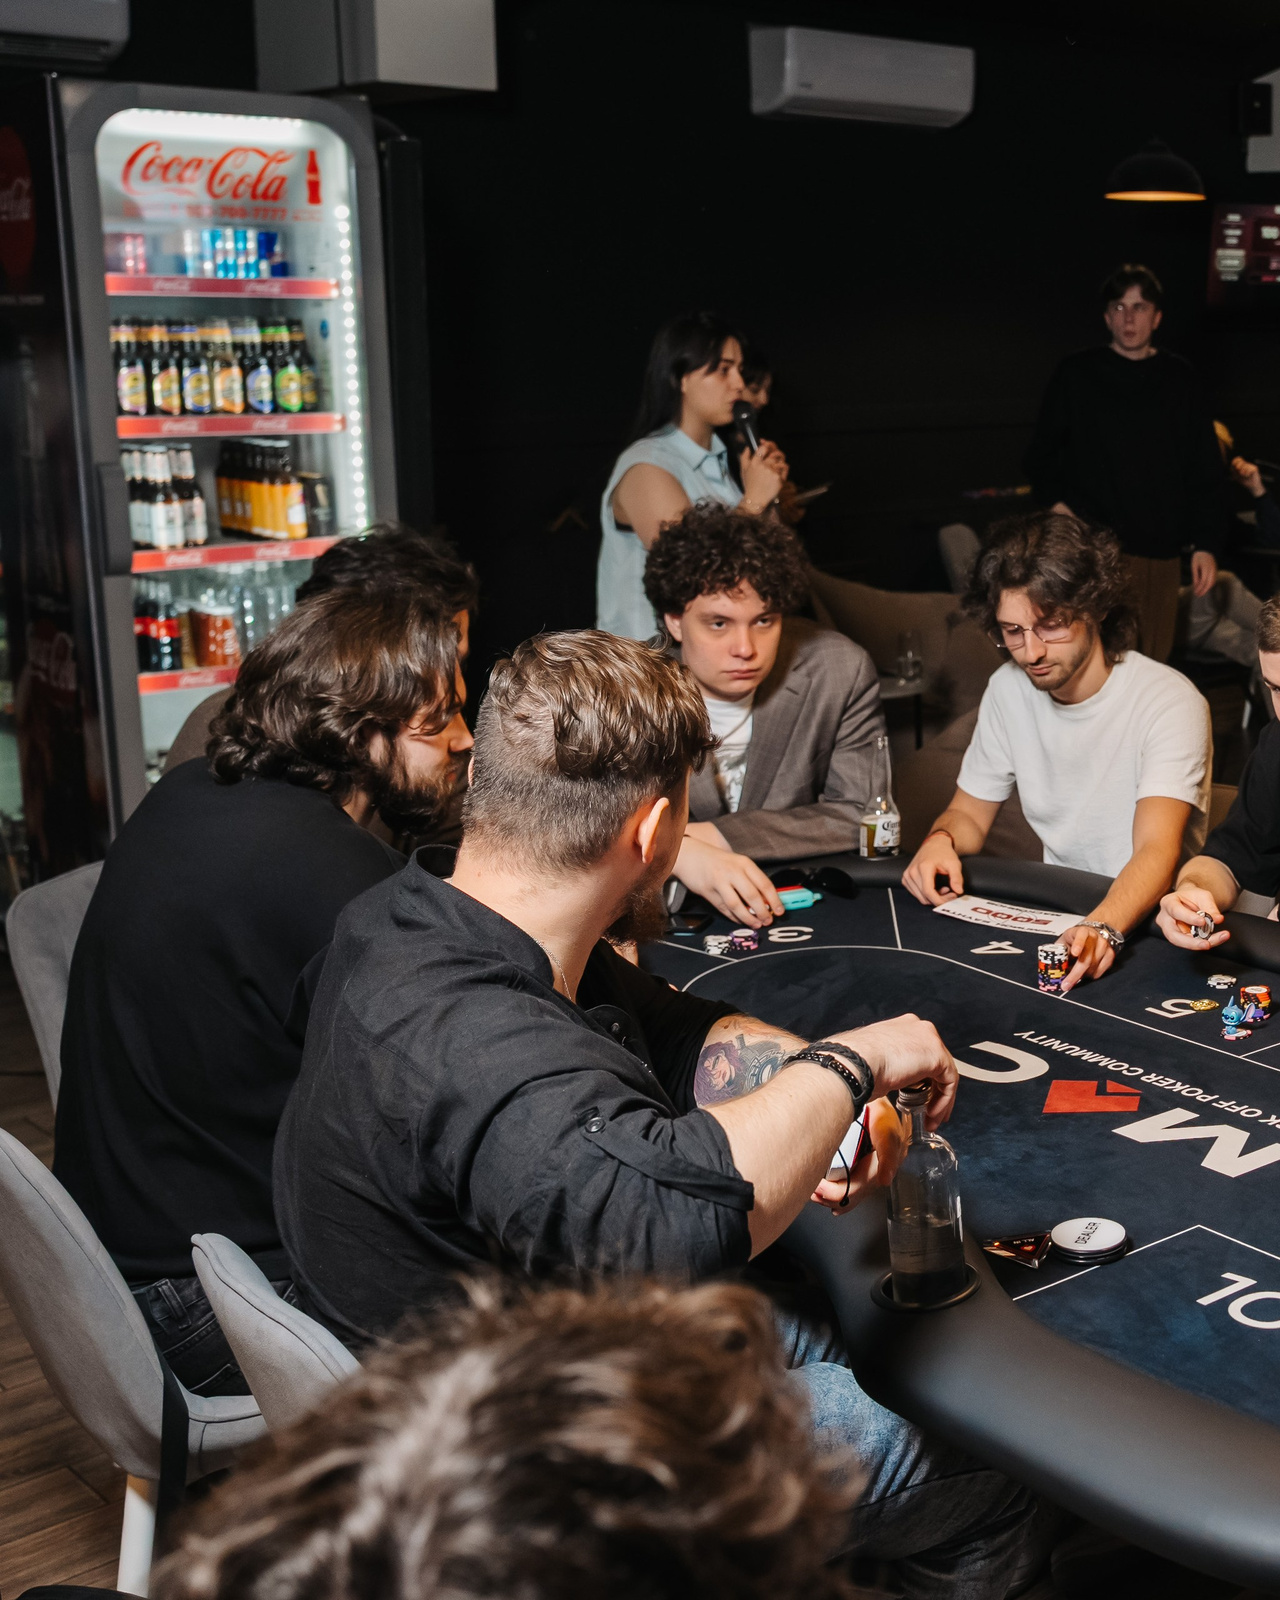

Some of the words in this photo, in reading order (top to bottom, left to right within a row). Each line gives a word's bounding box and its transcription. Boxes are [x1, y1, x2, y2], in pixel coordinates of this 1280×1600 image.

[121, 140, 296, 202] Coca-Cola
[971, 906, 1053, 925] 5000
[767, 925, 814, 942] 3
[970, 941, 1025, 955] 4
[1145, 998, 1199, 1019] 5
[1013, 1030, 1144, 1077] COMMUNITY
[1141, 1073, 1220, 1103] POKER
[1212, 1100, 1263, 1118] OFF
[1074, 1221, 1101, 1245] DEALER
